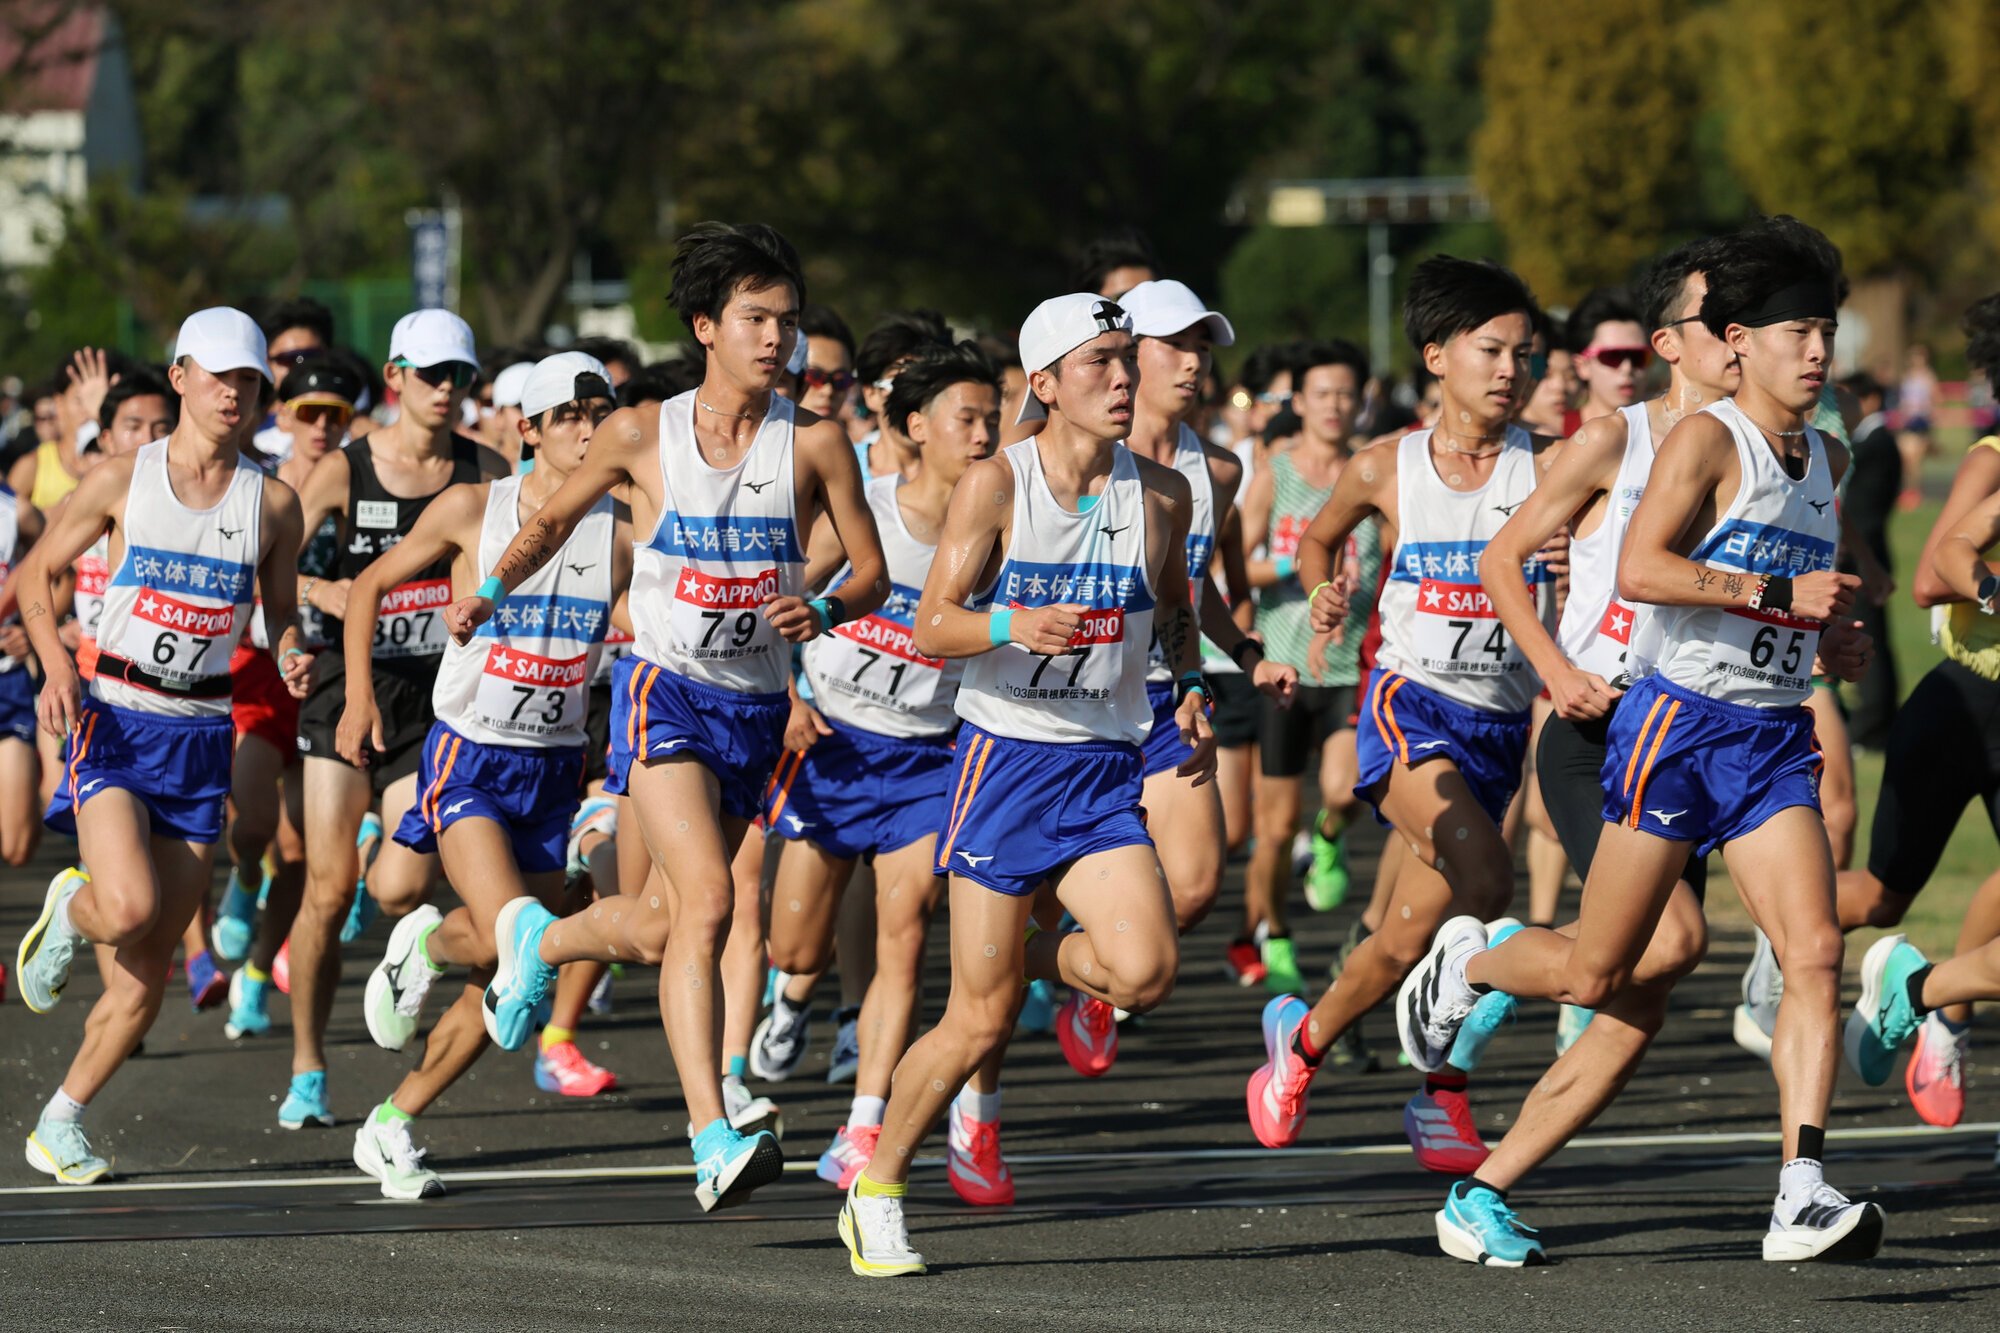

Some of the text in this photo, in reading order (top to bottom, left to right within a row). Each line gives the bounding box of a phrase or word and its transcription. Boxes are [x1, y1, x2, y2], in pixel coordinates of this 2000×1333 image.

[673, 522, 787, 552] 日本体育大学
[1725, 530, 1833, 573] 日本体育大学
[133, 555, 247, 596] 日本体育大学
[702, 576, 776, 604] SAPPORO
[1005, 571, 1136, 605] 日本体育大学
[381, 584, 449, 610] APPORO
[159, 603, 231, 632] SAPPORO
[490, 603, 602, 634] 本体育大学
[700, 611, 757, 648] 79
[152, 631, 212, 671] 67
[1448, 620, 1507, 661] 74
[1750, 626, 1805, 675] 65
[514, 657, 586, 684] SAPPORO
[853, 647, 907, 696] 71
[1029, 647, 1091, 687] 77
[510, 684, 567, 725] 73
[1005, 683, 1110, 700] 103回箱根駅伝予選会
